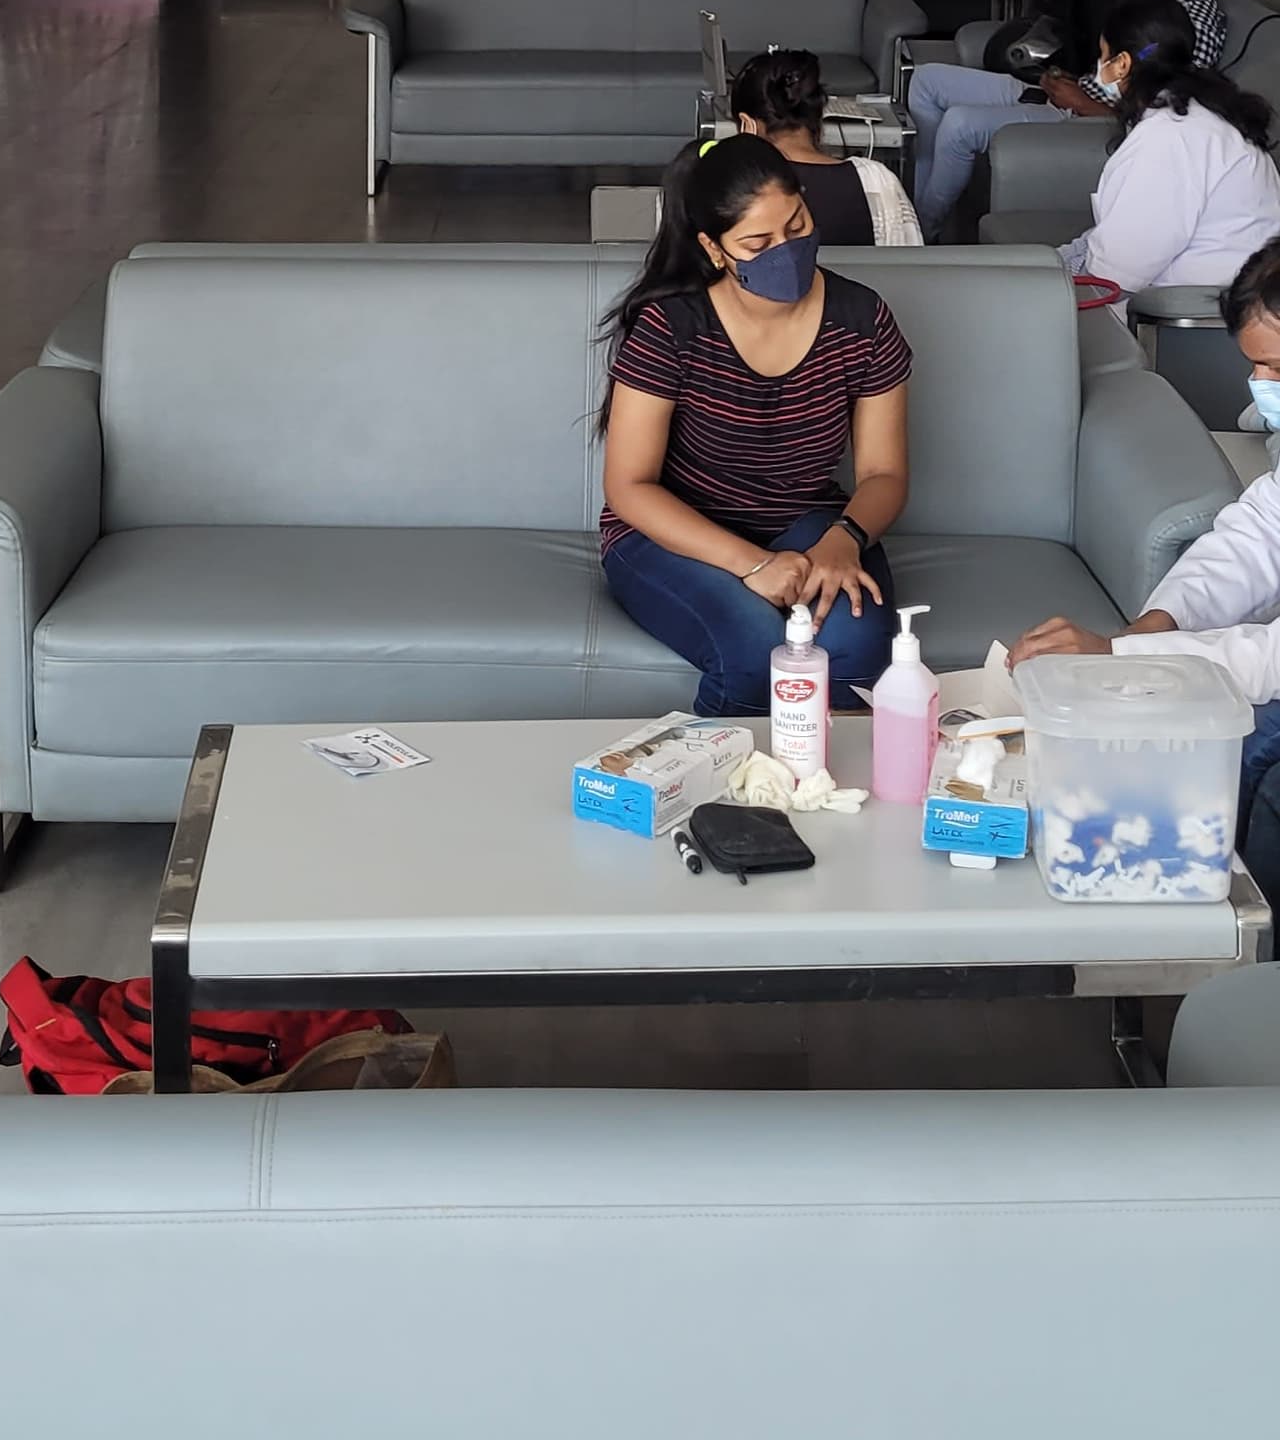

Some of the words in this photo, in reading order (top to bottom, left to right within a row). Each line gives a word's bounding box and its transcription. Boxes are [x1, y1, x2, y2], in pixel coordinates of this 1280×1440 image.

[780, 712, 806, 721] HAND
[775, 718, 818, 732] SANITIZER
[784, 739, 807, 750] Total
[578, 776, 616, 795] TroMed
[658, 778, 685, 801] TroMed
[934, 809, 980, 824] TroMed
[932, 827, 963, 838] LATEX
